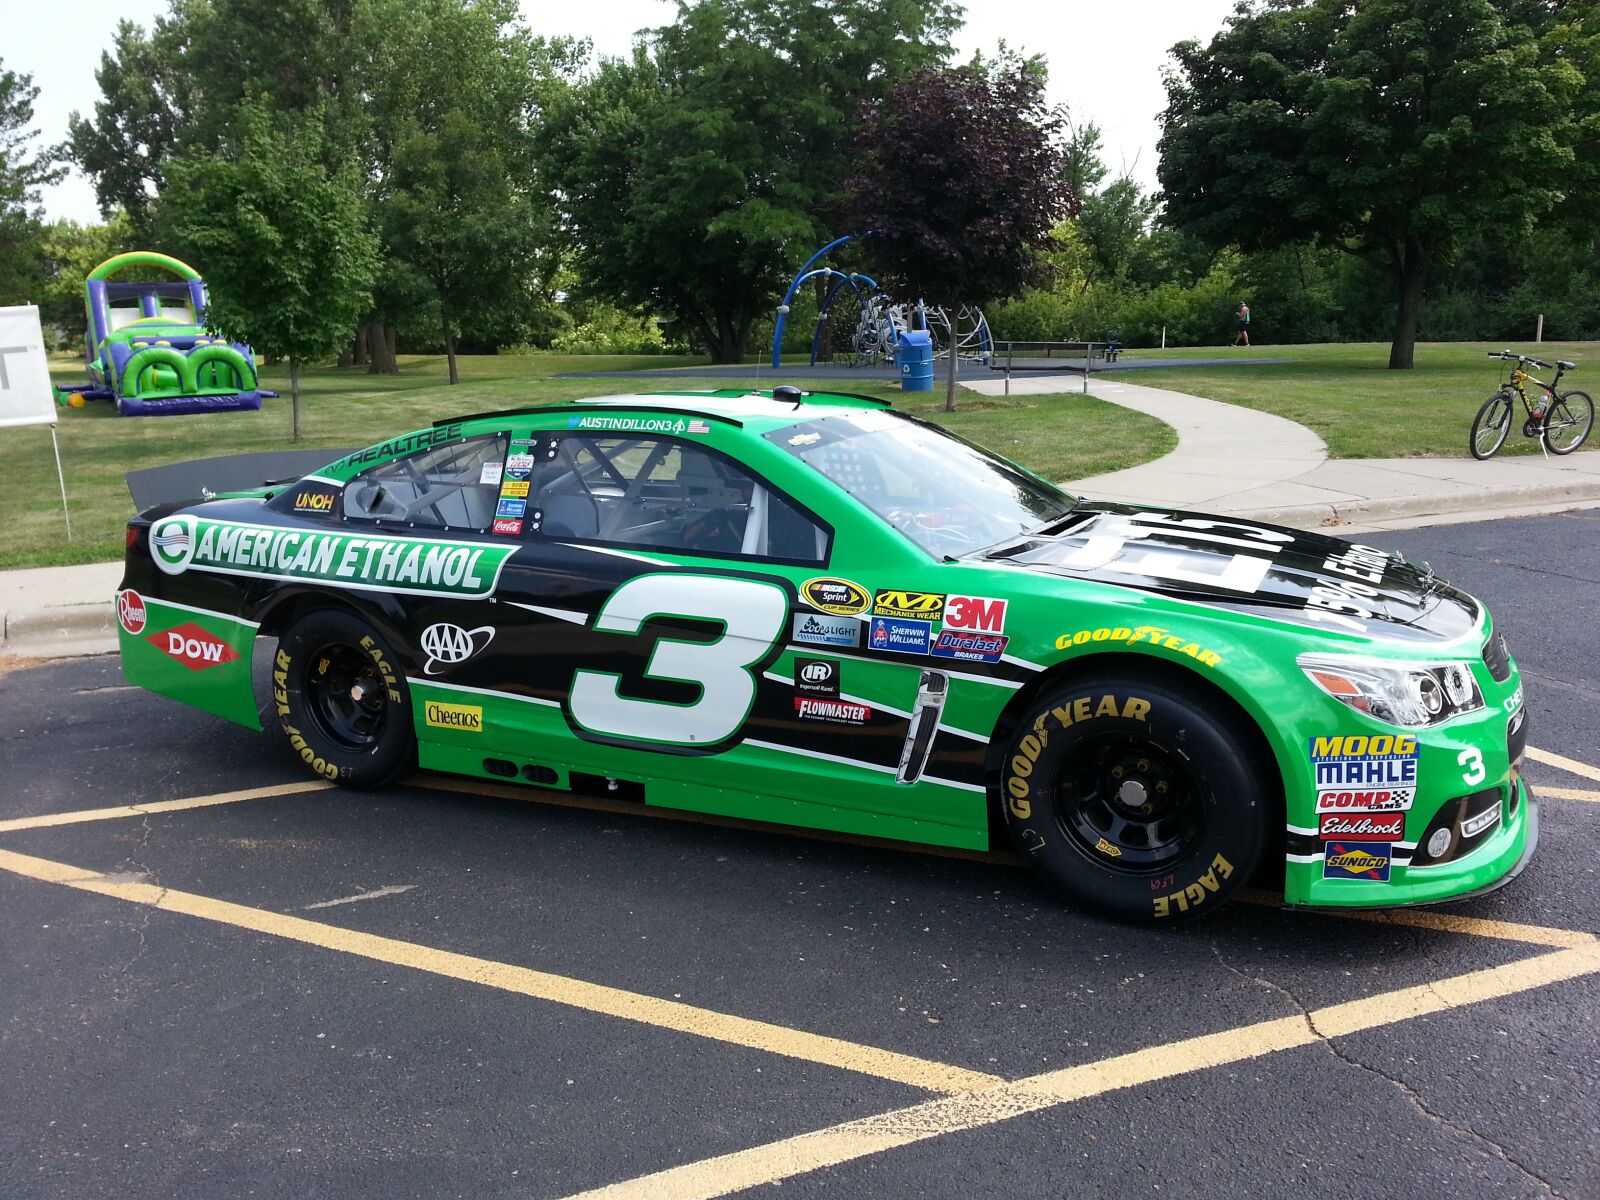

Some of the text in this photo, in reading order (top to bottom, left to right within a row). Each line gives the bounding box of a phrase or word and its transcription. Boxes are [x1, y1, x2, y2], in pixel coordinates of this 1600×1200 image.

[579, 417, 672, 431] AUSTINDILLON3
[348, 423, 462, 467] REALTREE
[295, 493, 334, 509] UNOH
[197, 525, 338, 574] AMERICAN
[336, 540, 484, 588] ETHANOL
[823, 592, 848, 602] Sprint
[119, 589, 146, 626] Rheem
[874, 606, 941, 621] MECHANIX WEAR
[946, 597, 1005, 632] 3M
[801, 621, 857, 637] Coors LIGHT
[890, 625, 926, 637] SHERWIN
[425, 623, 468, 662] AAA
[940, 634, 1002, 652] Duralast
[570, 575, 786, 743] 3
[954, 651, 984, 660] BRAKES
[360, 635, 401, 703] EAGLE
[806, 665, 827, 680] IR
[799, 684, 821, 692] Ingersoll
[428, 704, 479, 728] Cheerios
[799, 700, 866, 721] FLOWMASTER
[1312, 734, 1416, 757] MOOG
[1317, 760, 1415, 784] MAHLE
[1457, 747, 1486, 786] 3
[1320, 791, 1391, 808] COMP
[1321, 818, 1402, 835] Edelbrock
[1329, 856, 1386, 868] SUNOCO
[1153, 852, 1234, 917] EAGLE
